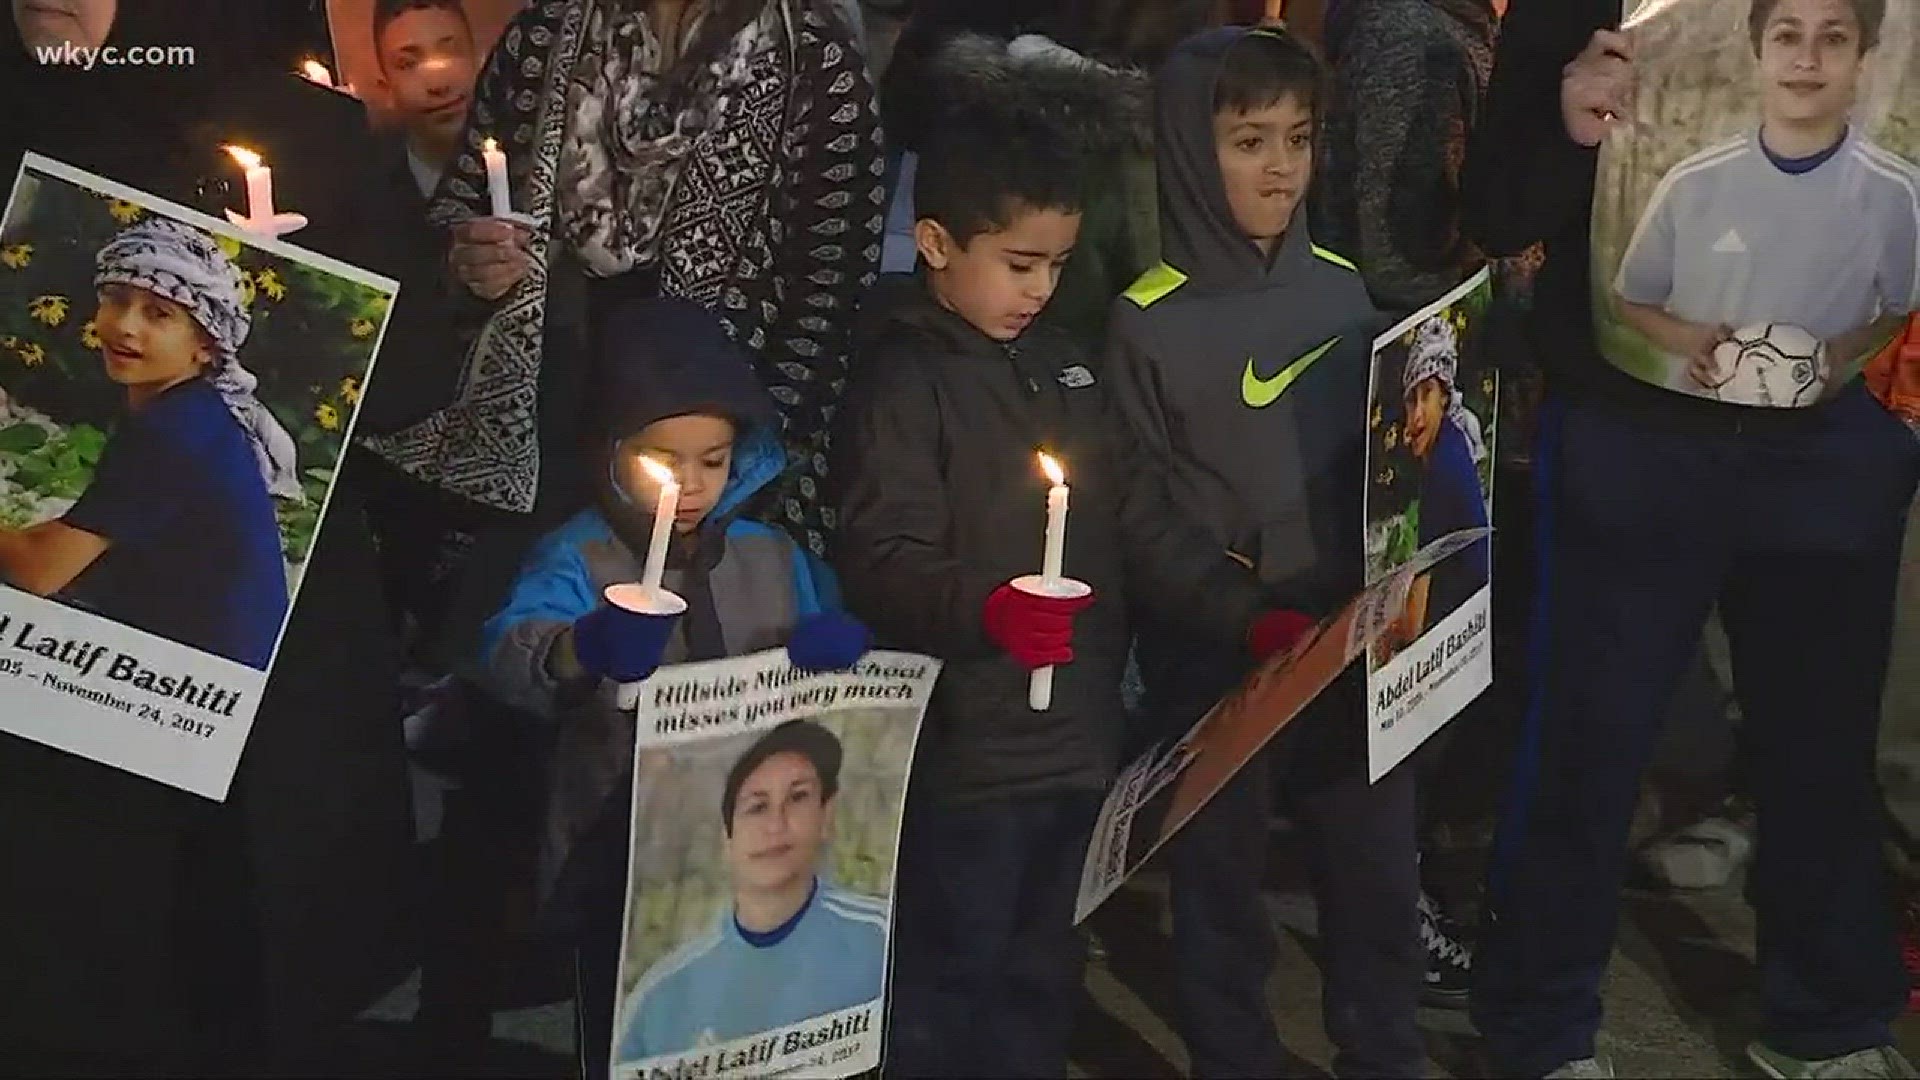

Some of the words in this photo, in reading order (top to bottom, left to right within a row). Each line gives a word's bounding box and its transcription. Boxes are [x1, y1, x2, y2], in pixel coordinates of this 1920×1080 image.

[13, 622, 109, 677] Latif
[106, 653, 242, 717] Bashiti
[1375, 665, 1413, 716] Abdel
[42, 671, 134, 714] November
[171, 712, 216, 739] 2017
[745, 696, 785, 725] you
[844, 683, 912, 699] much
[716, 1036, 779, 1074] Latif
[783, 1009, 871, 1055] Bashiti
